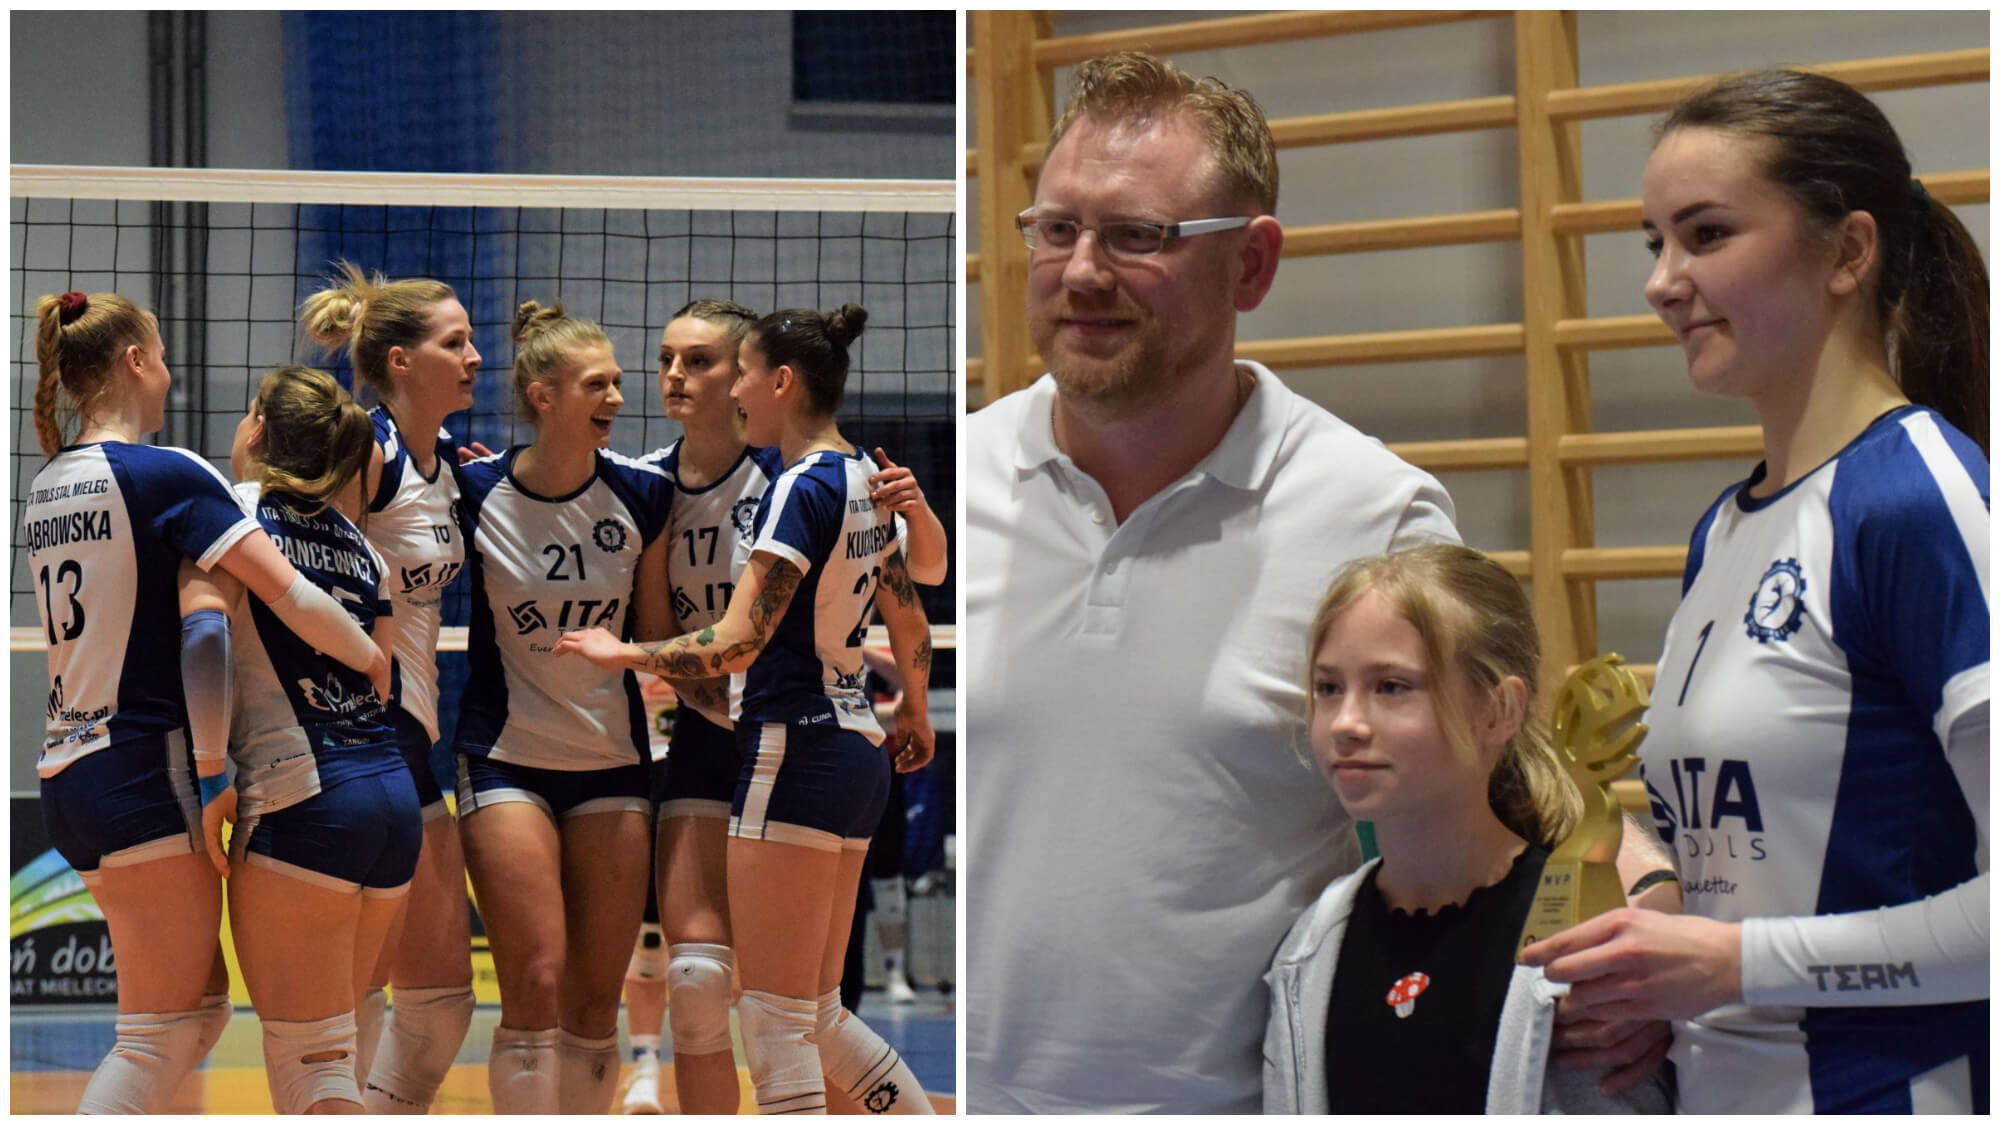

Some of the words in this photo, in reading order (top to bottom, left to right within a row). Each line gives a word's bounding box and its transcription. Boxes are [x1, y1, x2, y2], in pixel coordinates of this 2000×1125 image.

[55, 484, 71, 501] STAL
[72, 479, 109, 497] MIELEC
[261, 506, 281, 521] ITA
[23, 510, 113, 557] ĄBROWSKA
[432, 525, 450, 545] 10
[683, 526, 719, 567] 17
[543, 544, 586, 581] 21
[39, 560, 85, 646] 13
[705, 582, 735, 611] IT
[557, 598, 620, 628] ITA
[1669, 757, 1765, 833] ITA
[1543, 873, 1571, 887] MVP
[10, 937, 37, 975] ń
[50, 934, 116, 975] dob
[1807, 961, 1921, 992] TEAM
